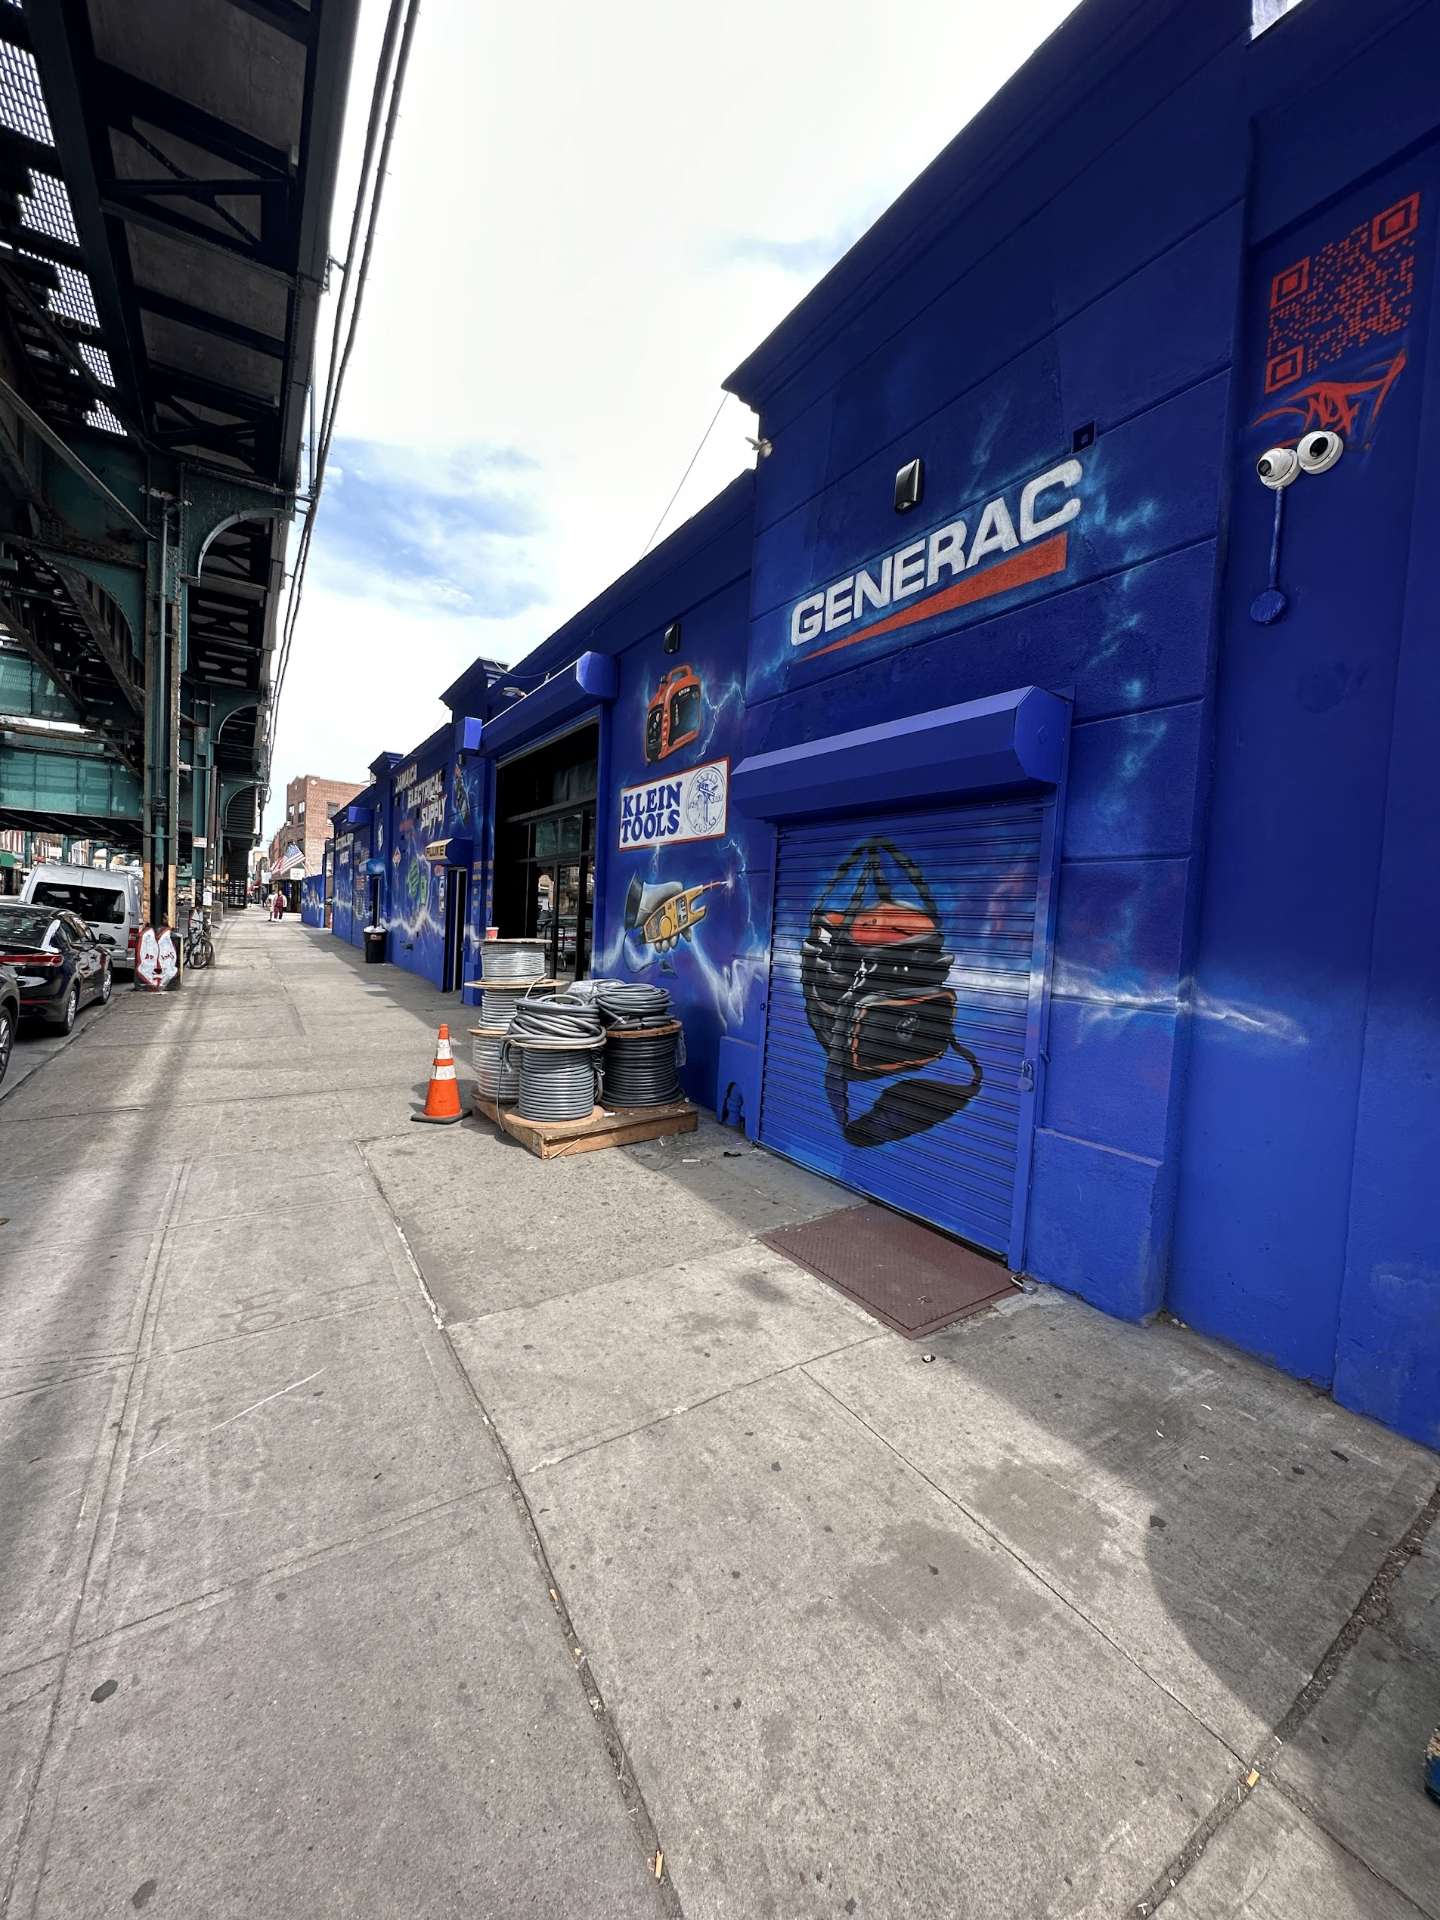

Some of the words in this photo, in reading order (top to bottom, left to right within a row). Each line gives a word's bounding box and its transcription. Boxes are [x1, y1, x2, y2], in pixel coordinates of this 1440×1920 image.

[791, 459, 1083, 646] GENERAC
[421, 794, 447, 831] SUPPLY
[622, 781, 683, 818] KLEIN
[622, 809, 681, 843] TOOLS
[426, 845, 444, 857] FLUKE
